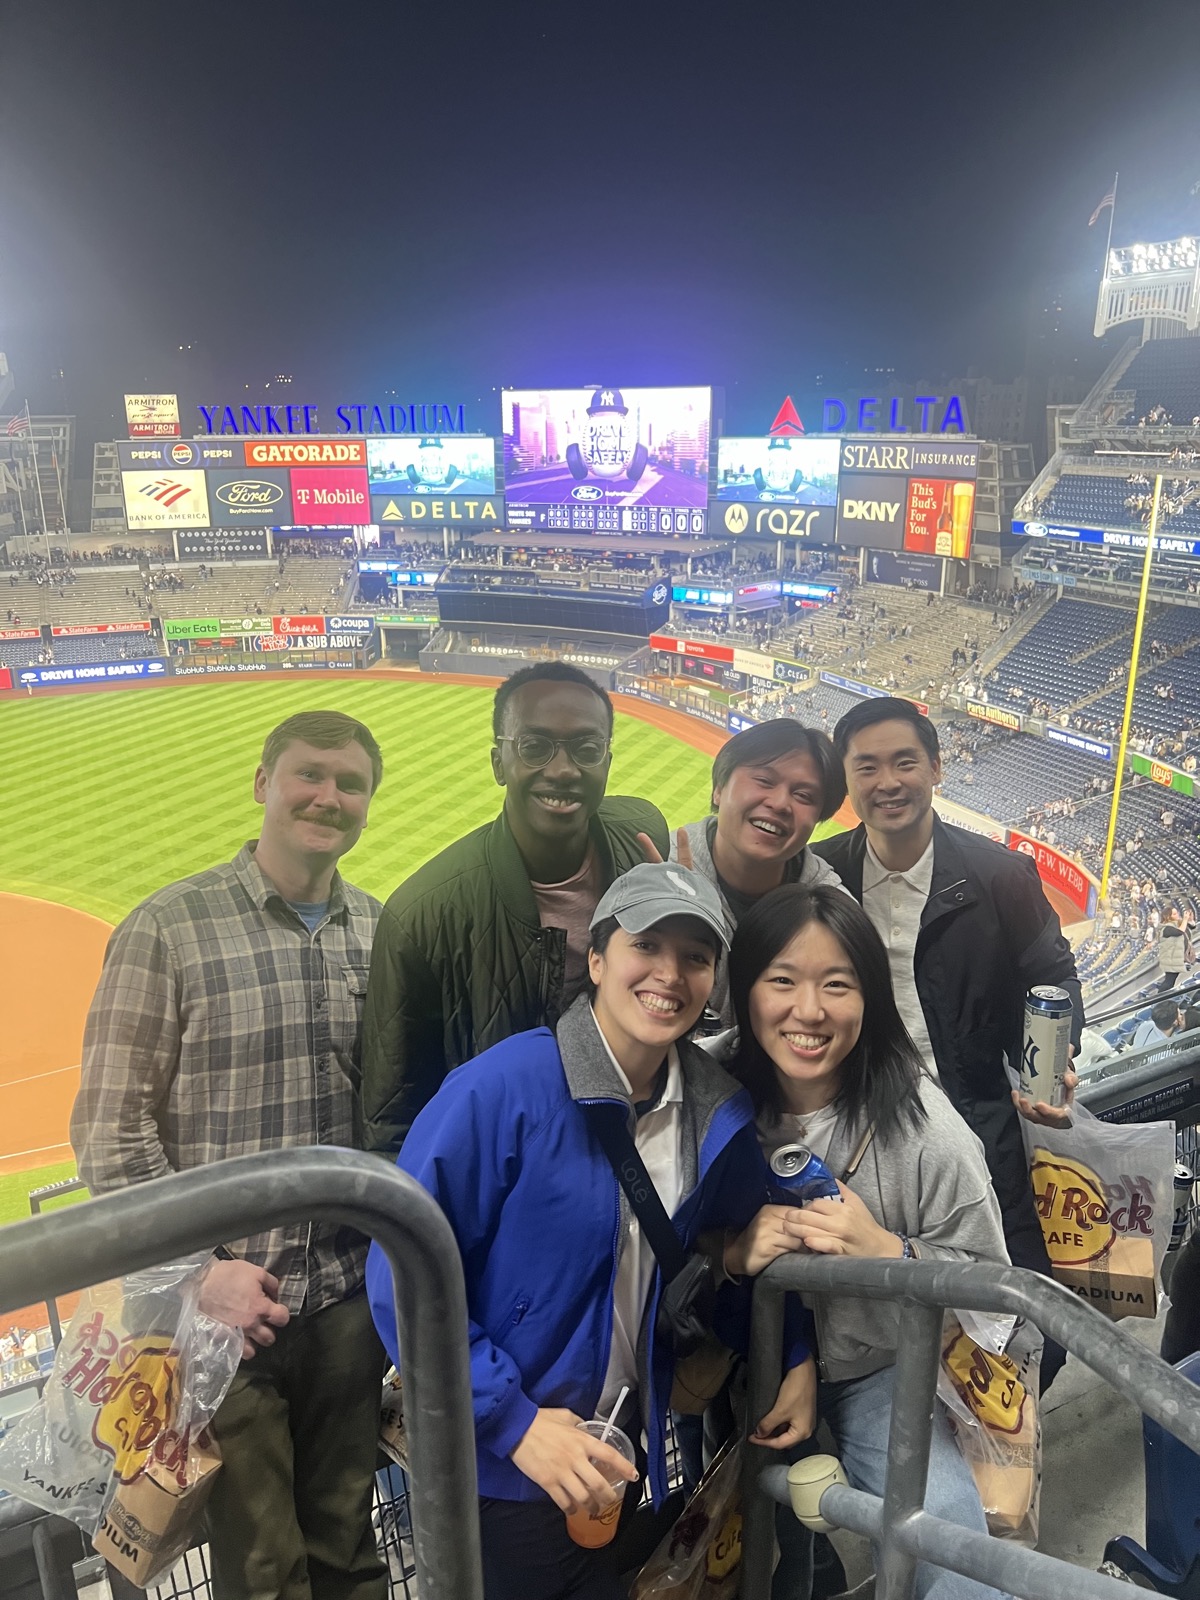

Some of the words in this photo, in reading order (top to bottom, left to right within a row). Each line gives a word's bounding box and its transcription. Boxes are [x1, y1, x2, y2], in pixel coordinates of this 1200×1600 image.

[197, 405, 320, 434] YANKEE
[336, 404, 467, 434] STADIUM
[822, 396, 967, 433] DELTA
[131, 451, 162, 460] PEPSI
[203, 450, 233, 459] PEPSI
[252, 444, 361, 462] GATORADE
[843, 445, 910, 470] STARR
[915, 452, 976, 467] INSURANCE
[228, 484, 271, 502] Ford
[314, 489, 365, 504] Mobile
[912, 482, 934, 496] This
[411, 501, 497, 519] DELTA
[911, 496, 937, 510] Bud's
[129, 514, 153, 522] BANK
[166, 512, 208, 520] AMERICA
[843, 499, 900, 523] DKNY
[910, 510, 927, 523] For
[756, 508, 820, 536] razr
[909, 522, 930, 535] You.
[1103, 533, 1131, 545] DRIVE
[1160, 538, 1195, 553] SAFELY
[167, 625, 192, 635] Uber
[193, 624, 217, 633] Eats
[342, 619, 369, 629] coupa
[297, 636, 305, 647] A
[306, 635, 328, 648] SUB
[330, 635, 363, 648] ABOVE
[686, 645, 704, 653] TOYOTA
[41, 670, 74, 681] DRIVE
[76, 667, 106, 678] HOME
[108, 664, 144, 676] SAFELY
[753, 677, 771, 688] BUILD
[967, 702, 986, 716] Parts
[985, 706, 1019, 727] Authority
[940, 813, 950, 822] OF
[1037, 849, 1056, 872] F.W.
[1058, 860, 1083, 892] WEBB
[1127, 1101, 1143, 1113] LEAN
[1061, 1183, 1154, 1236] Rock
[1064, 1283, 1144, 1304] TADIUM
